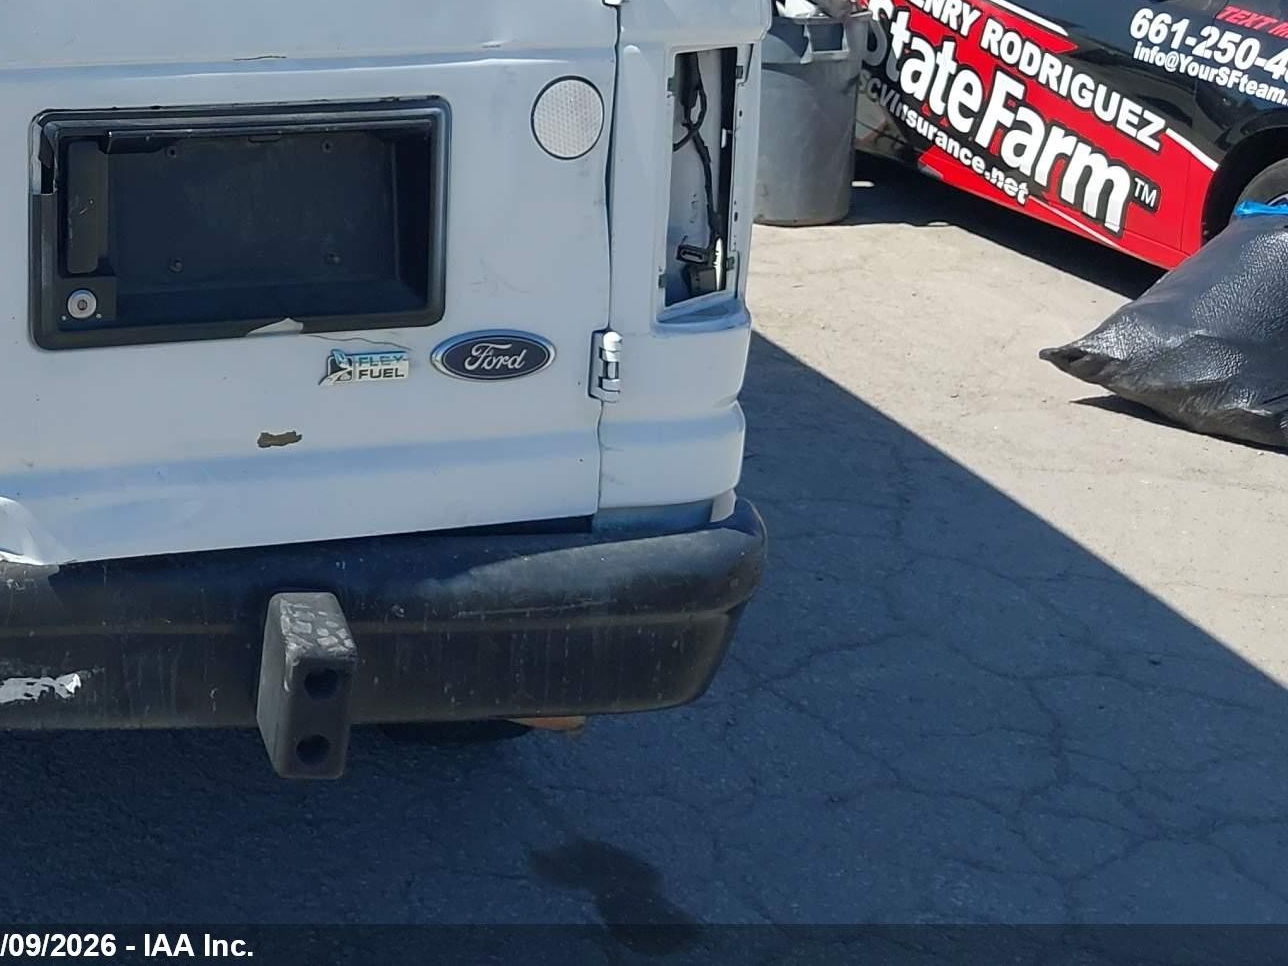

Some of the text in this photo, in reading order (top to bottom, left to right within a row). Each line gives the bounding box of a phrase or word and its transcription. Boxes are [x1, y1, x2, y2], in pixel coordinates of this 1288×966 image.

[1216, 5, 1279, 32] TEXT
[1130, 7, 1288, 84] 661-250-4
[980, 17, 1166, 152] RODRIGUEZ
[1133, 41, 1288, 107] info@YourSFteam.
[357, 354, 405, 367] FLEX
[464, 342, 526, 371] Ford
[358, 367, 405, 380] FUEL
